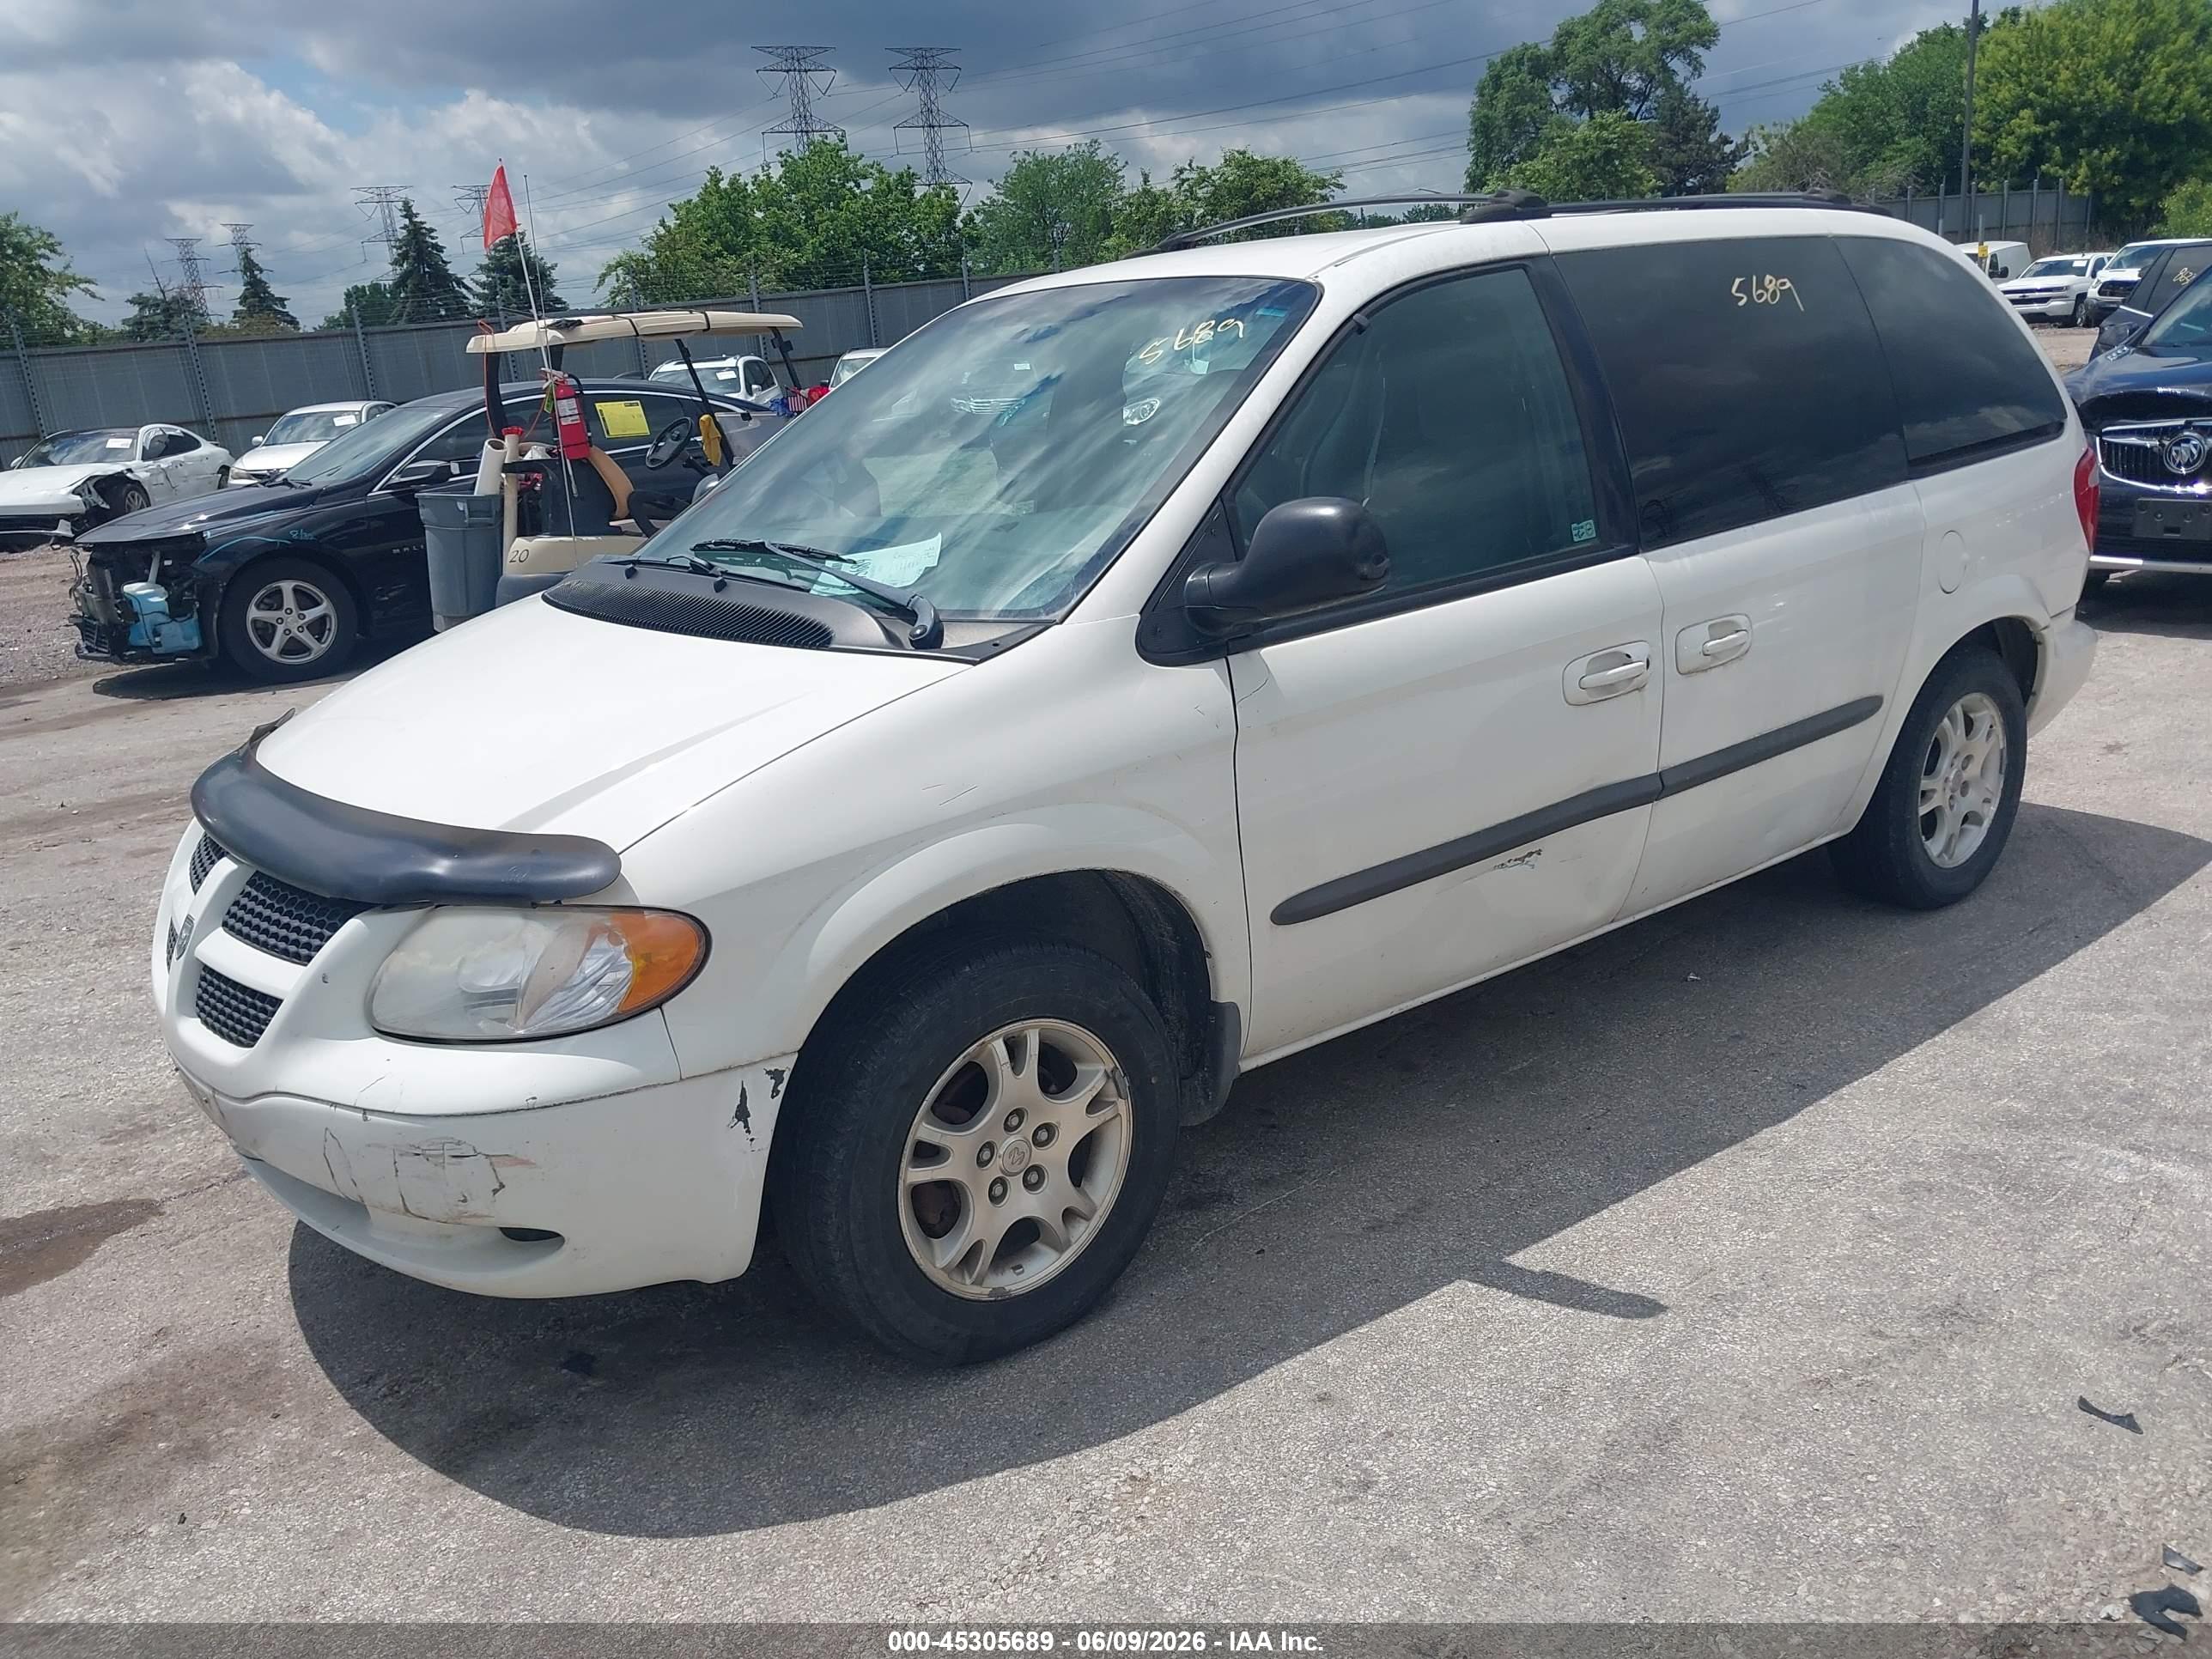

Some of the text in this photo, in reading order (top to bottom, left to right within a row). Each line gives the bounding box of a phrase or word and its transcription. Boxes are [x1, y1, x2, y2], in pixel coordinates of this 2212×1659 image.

[1731, 274, 1805, 311] 5689
[1139, 318, 1244, 365] 5689
[508, 549, 530, 563] 20
